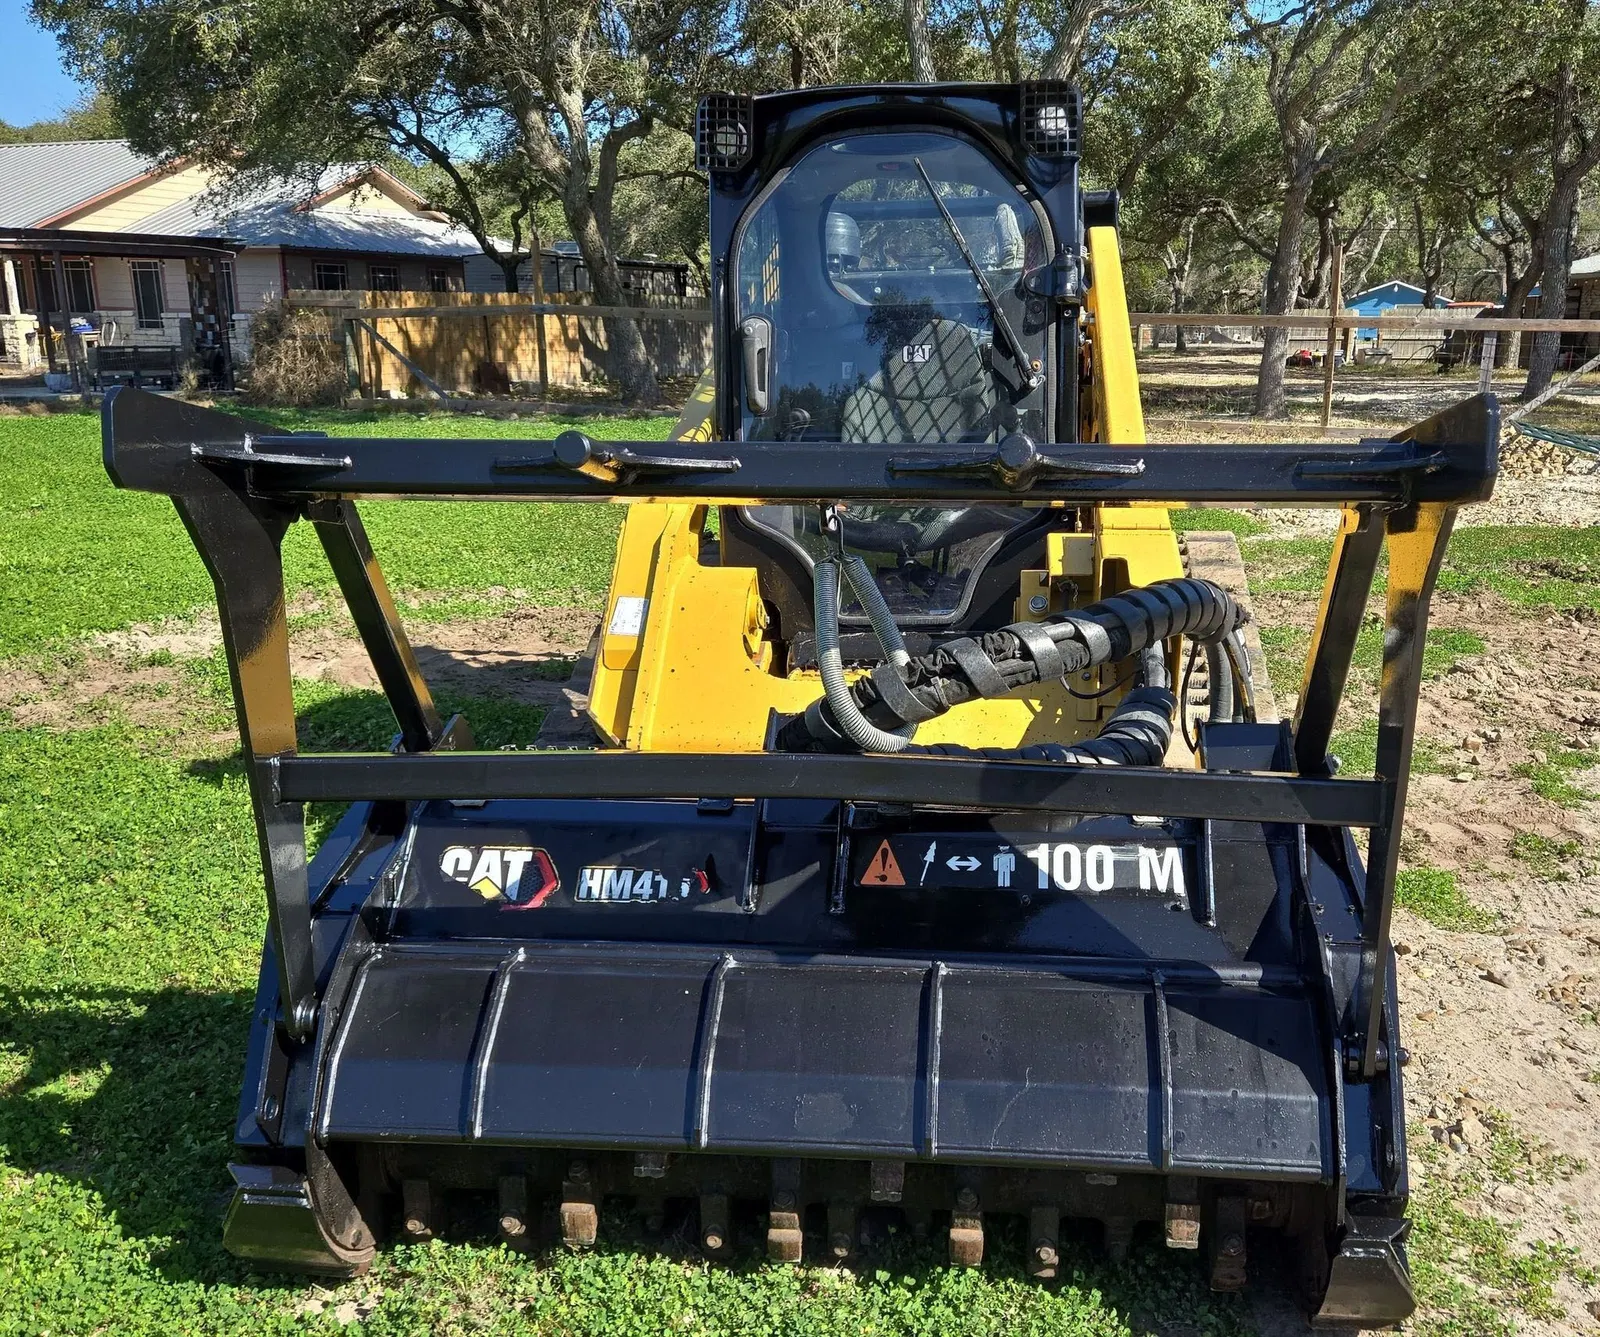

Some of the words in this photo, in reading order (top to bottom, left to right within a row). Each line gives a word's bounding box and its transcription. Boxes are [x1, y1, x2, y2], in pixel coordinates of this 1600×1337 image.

[902, 344, 931, 362] CAT
[440, 848, 533, 900] CAT
[1027, 843, 1114, 892] 100
[1138, 845, 1185, 896] M
